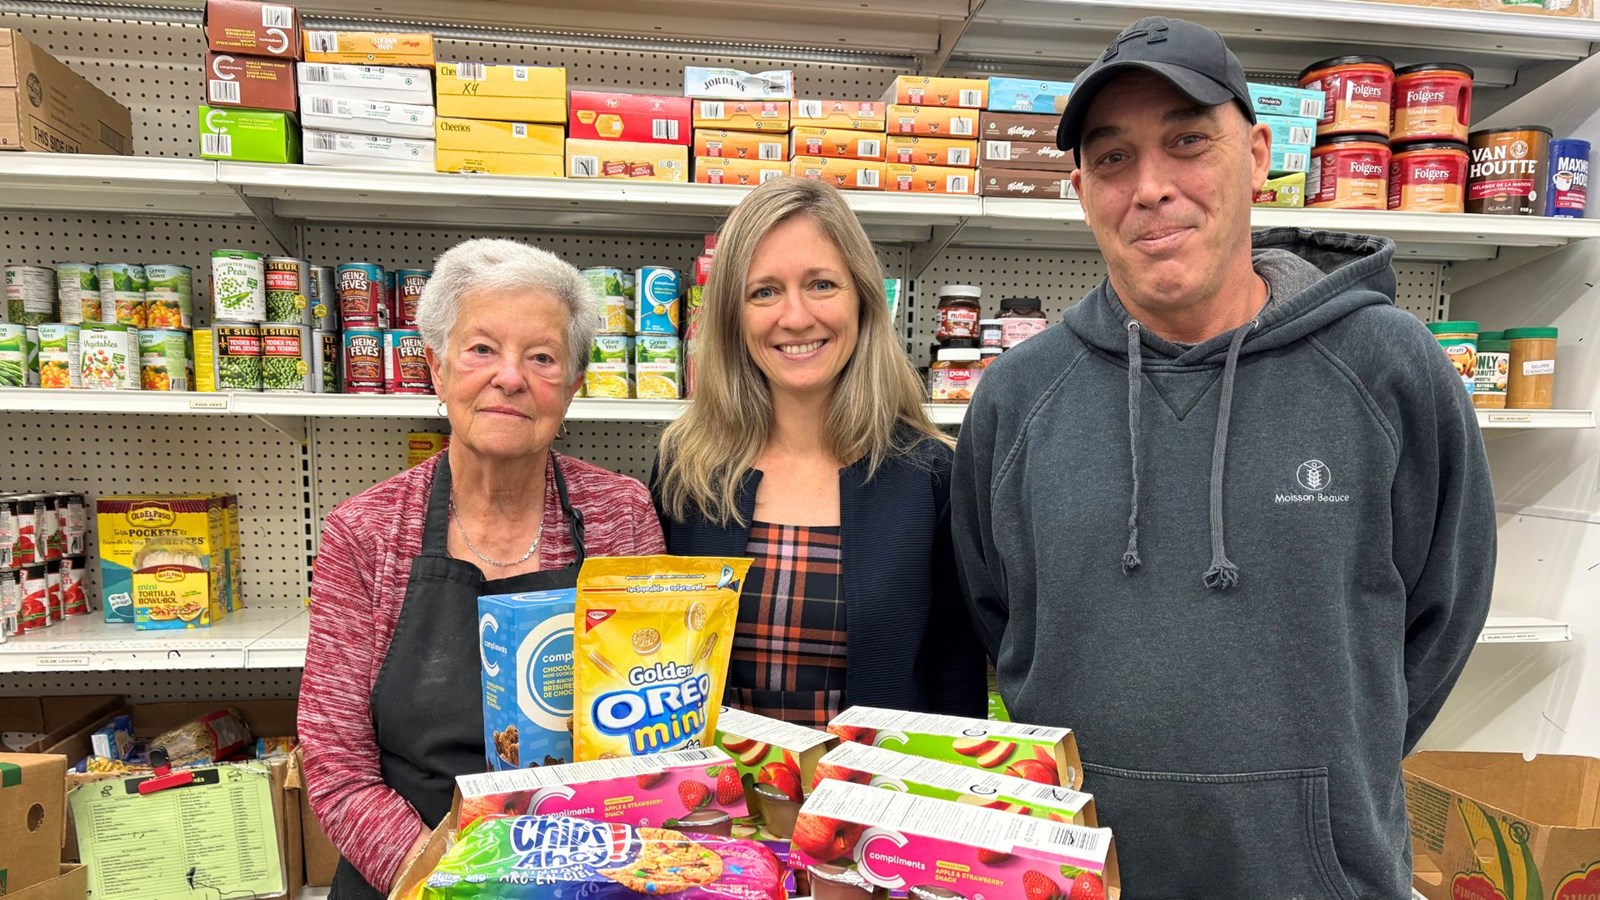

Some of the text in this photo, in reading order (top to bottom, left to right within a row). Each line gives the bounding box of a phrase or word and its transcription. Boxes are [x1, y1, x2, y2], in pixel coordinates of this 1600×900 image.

[704, 77, 747, 93] JORDANS
[1352, 83, 1382, 97] Folgers
[1407, 90, 1444, 103] Folgers
[441, 122, 471, 132] Cheerios
[1007, 126, 1037, 138] Kellogg's
[33, 125, 48, 146] THIS
[1472, 145, 1507, 162] VAN
[1350, 161, 1382, 175] Folgers
[1415, 168, 1450, 180] Folgers
[1470, 160, 1538, 178] HOUTTE
[1007, 180, 1036, 193] Kellogg's
[228, 267, 247, 276] Peas
[342, 272, 365, 280] HEINZ
[341, 281, 367, 290] FEVES
[351, 347, 378, 356] FEVES
[1275, 493, 1350, 503] Moisson Beauce
[131, 511, 144, 520] OLD
[154, 510, 170, 520] PASO
[629, 661, 694, 686] Golden
[596, 674, 709, 728] OREO
[635, 703, 704, 752] mini
[628, 799, 663, 808] STRAWBERRY
[512, 816, 608, 852] Chips
[870, 852, 926, 870] compliments
[935, 868, 955, 878] APPLE
[962, 873, 1005, 886] STRAWBERRY
[935, 874, 957, 884] SNACK
